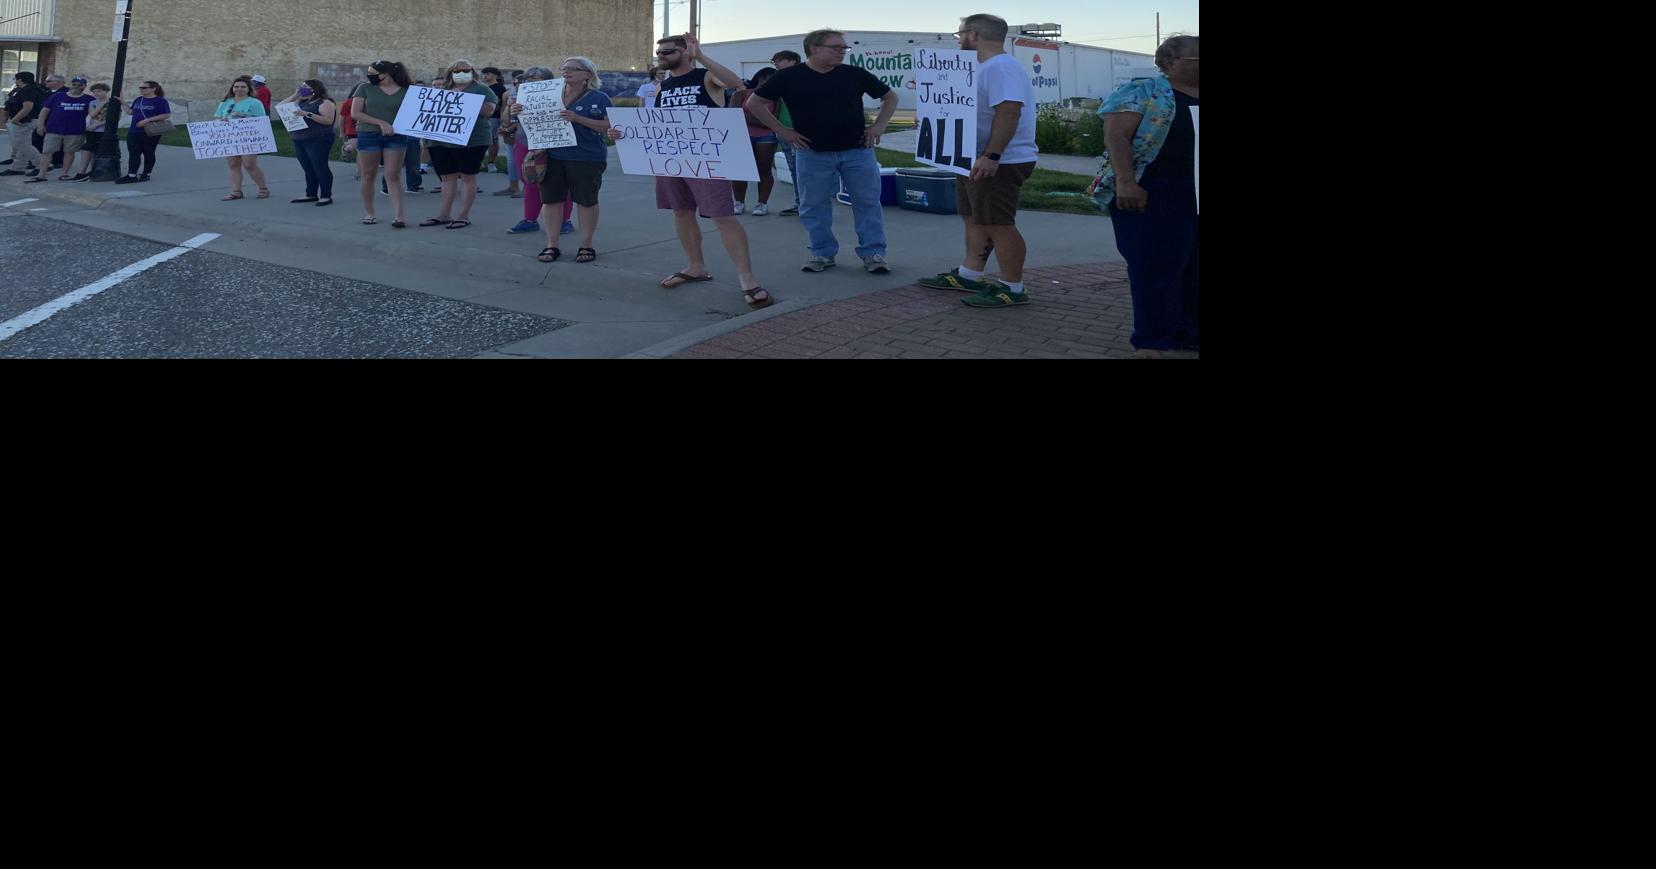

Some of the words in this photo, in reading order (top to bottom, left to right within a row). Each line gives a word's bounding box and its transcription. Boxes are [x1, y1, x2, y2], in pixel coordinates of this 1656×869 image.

[916, 49, 976, 87] Liberty
[529, 81, 553, 91] STOP
[879, 75, 904, 88] ew
[418, 88, 464, 105] BLACK
[526, 95, 553, 103] RACIAL
[660, 85, 701, 99] BLACK
[920, 82, 975, 107] Justice
[419, 100, 463, 115] LIVES
[660, 95, 697, 108] LIVES
[411, 112, 472, 135] MATTER!
[522, 115, 561, 123] OPPRESSIO
[636, 108, 711, 125] UNITY
[228, 129, 260, 138] MATTER
[613, 124, 729, 143] SOLIDARITY
[195, 138, 233, 147] ONWARD
[643, 140, 722, 157] RESPECT
[917, 117, 972, 171] ALL
[198, 143, 268, 158] TOGETHER
[649, 158, 726, 179] LOVE
